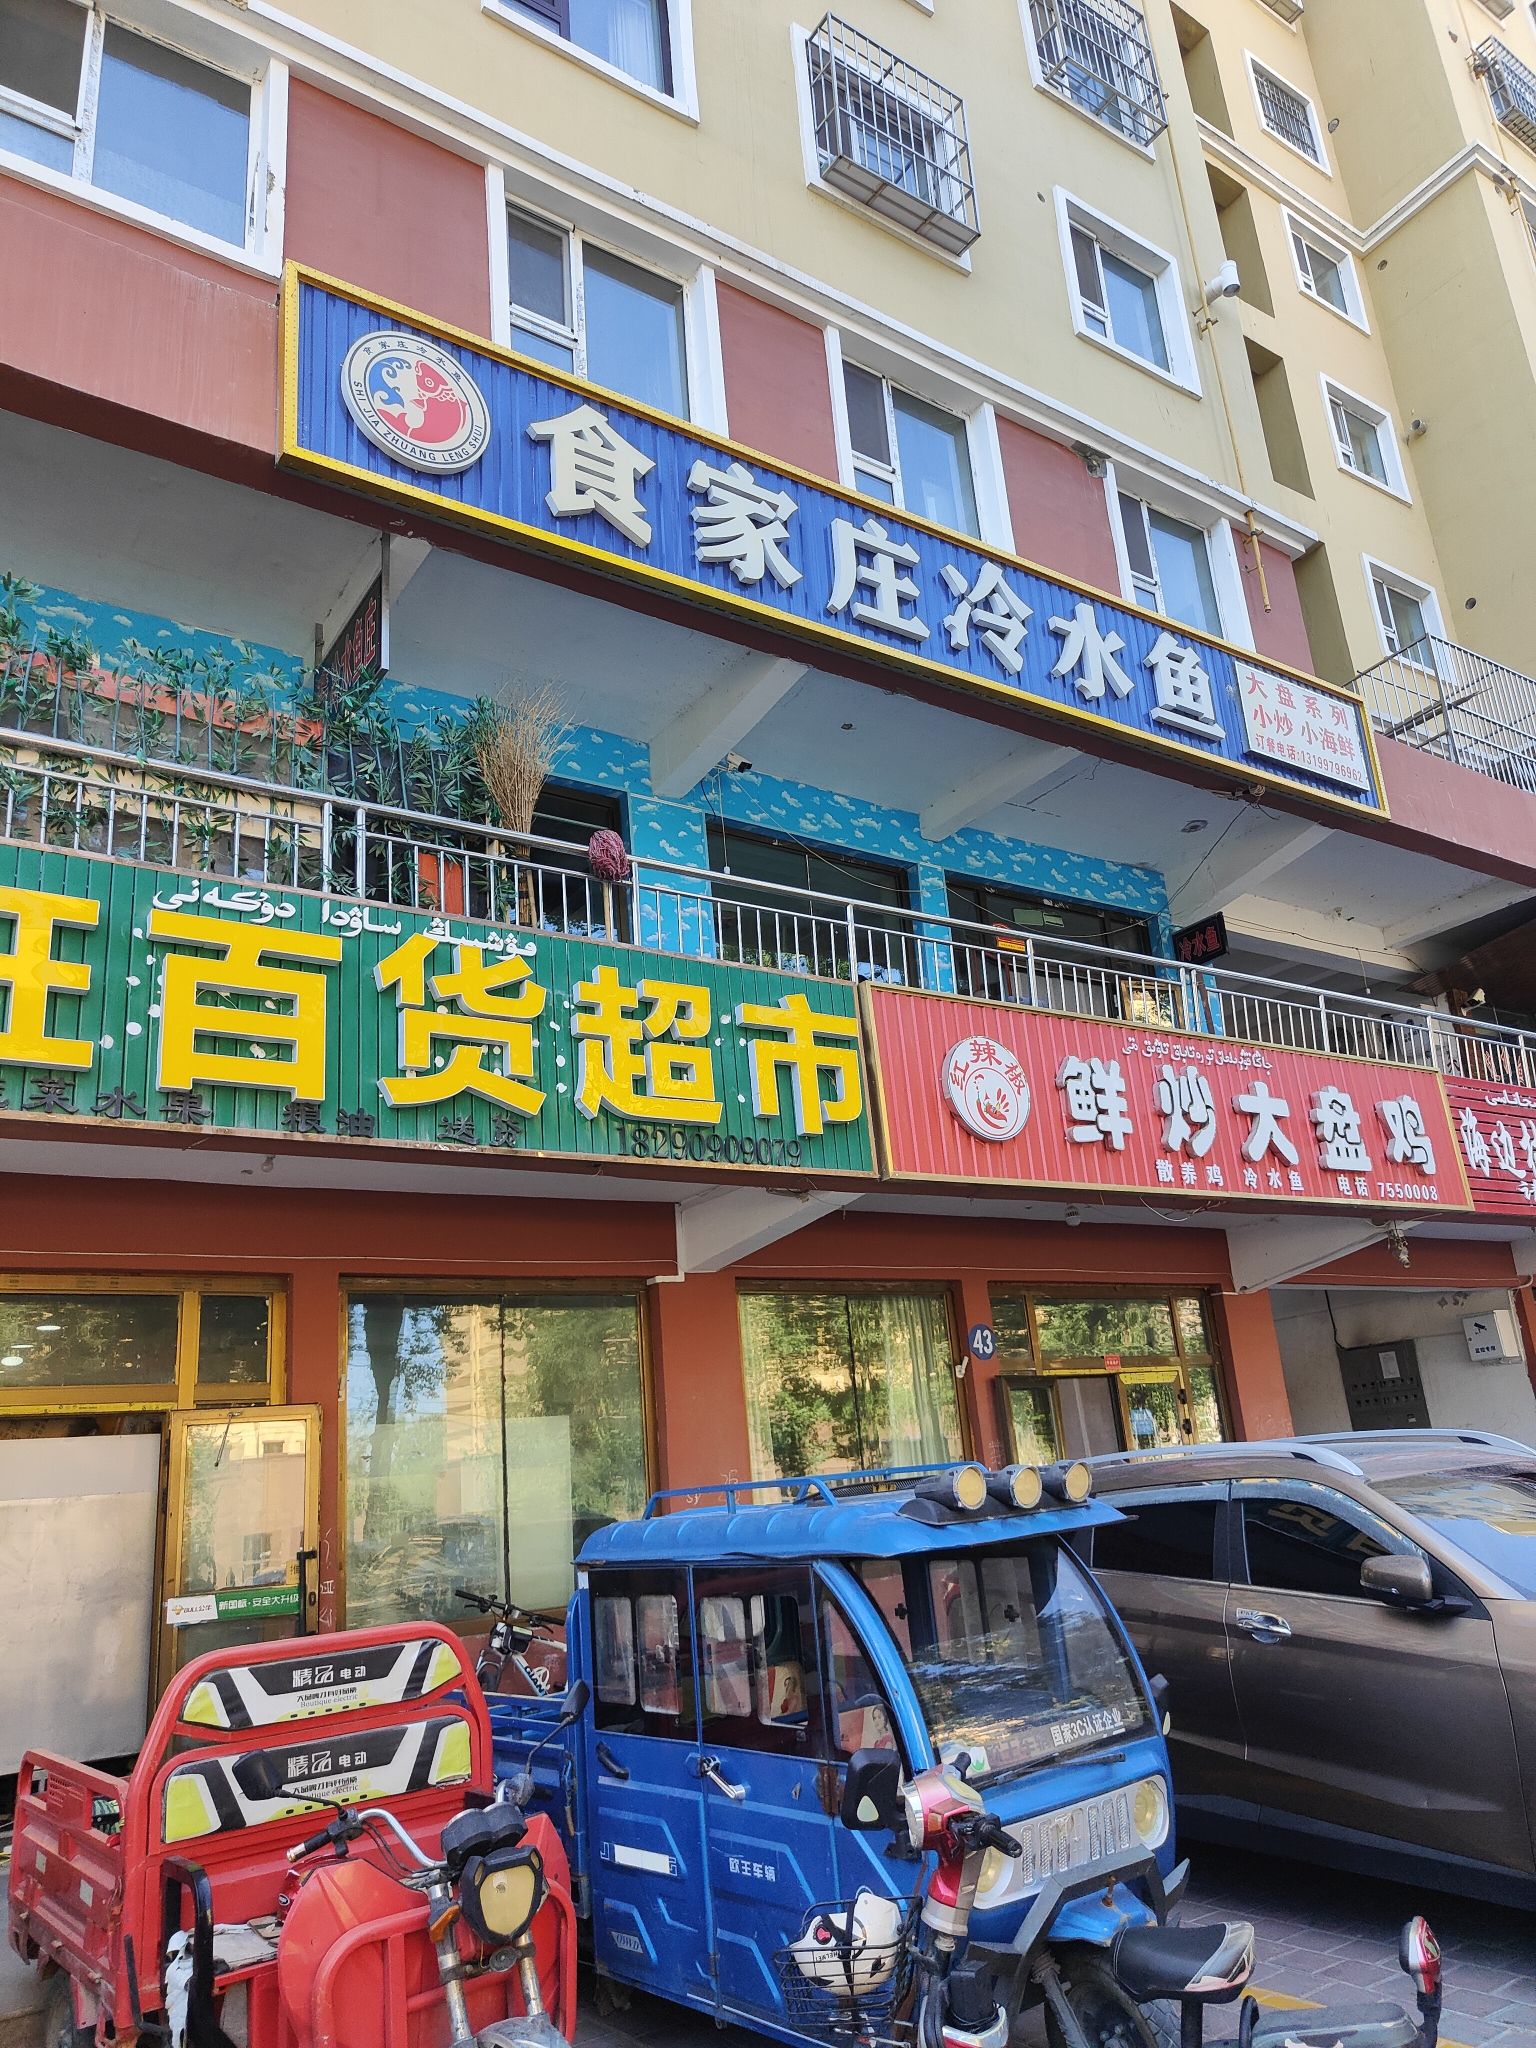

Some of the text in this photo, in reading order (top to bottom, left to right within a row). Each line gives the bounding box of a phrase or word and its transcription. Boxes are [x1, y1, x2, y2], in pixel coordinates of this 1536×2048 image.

[353, 380, 483, 462] SHI JIA ZHUANG LENG SHUI
[527, 403, 1226, 743] 食家庄冷水鱼
[1246, 672, 1349, 731] 大盘系列
[1253, 704, 1356, 762] 小炒 小海鲜
[1179, 926, 1220, 961] 冷水鱼
[950, 1040, 1025, 1096] 红辣椒
[0, 1073, 213, 1125] 菜水果
[281, 1103, 375, 1138] 粮油
[1055, 1056, 1437, 1176] 鲜炒大盘鸡
[617, 1127, 801, 1167] 18290909079
[1155, 1160, 1438, 1201] 散养鸡 冷水鱼 电话 7550008
[973, 1330, 993, 1354] 43
[292, 1665, 366, 1688] 精品 电动
[1050, 1707, 1125, 1748] 国家3C认证企业
[288, 1750, 367, 1779] 精品 电动
[729, 1856, 776, 1883] 欧王车辆
